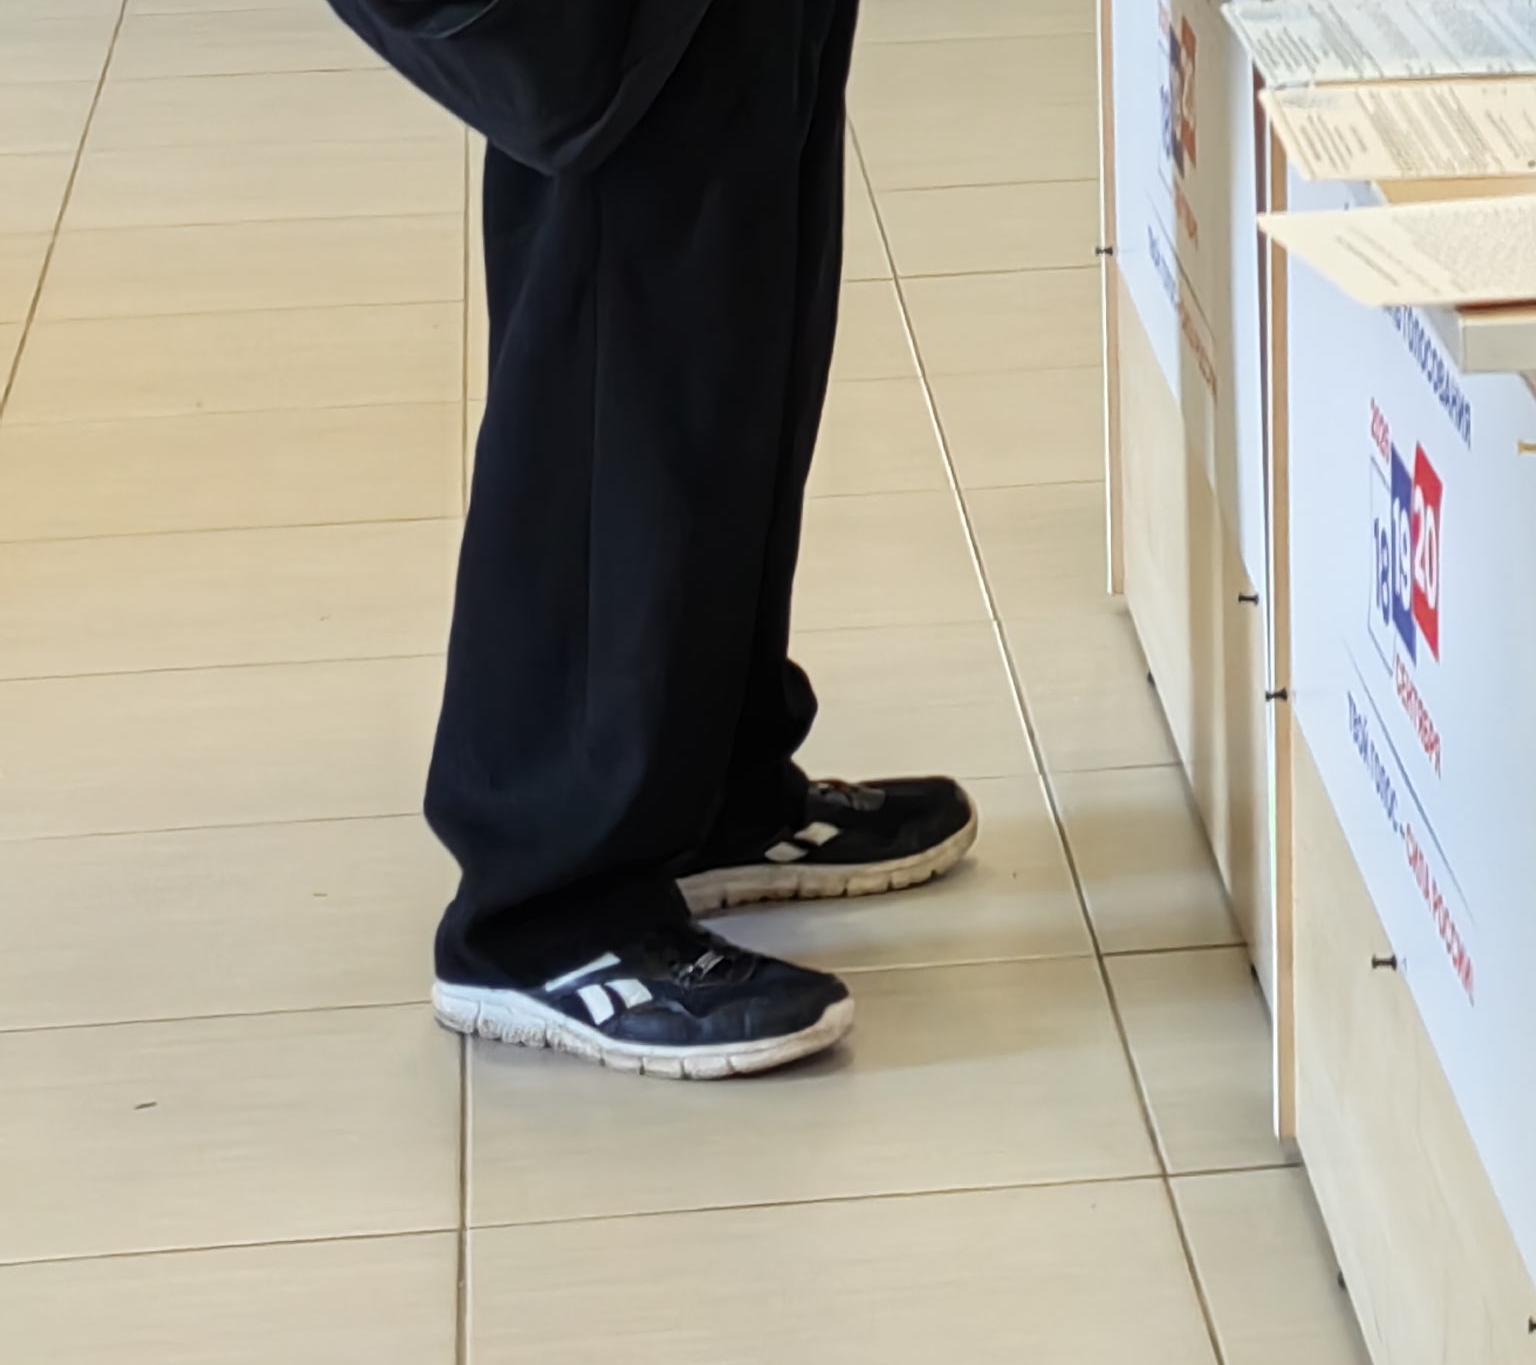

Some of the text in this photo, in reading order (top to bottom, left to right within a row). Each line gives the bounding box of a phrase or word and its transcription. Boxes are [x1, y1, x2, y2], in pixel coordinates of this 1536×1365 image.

[1373, 484, 1437, 627] 18 19 20
